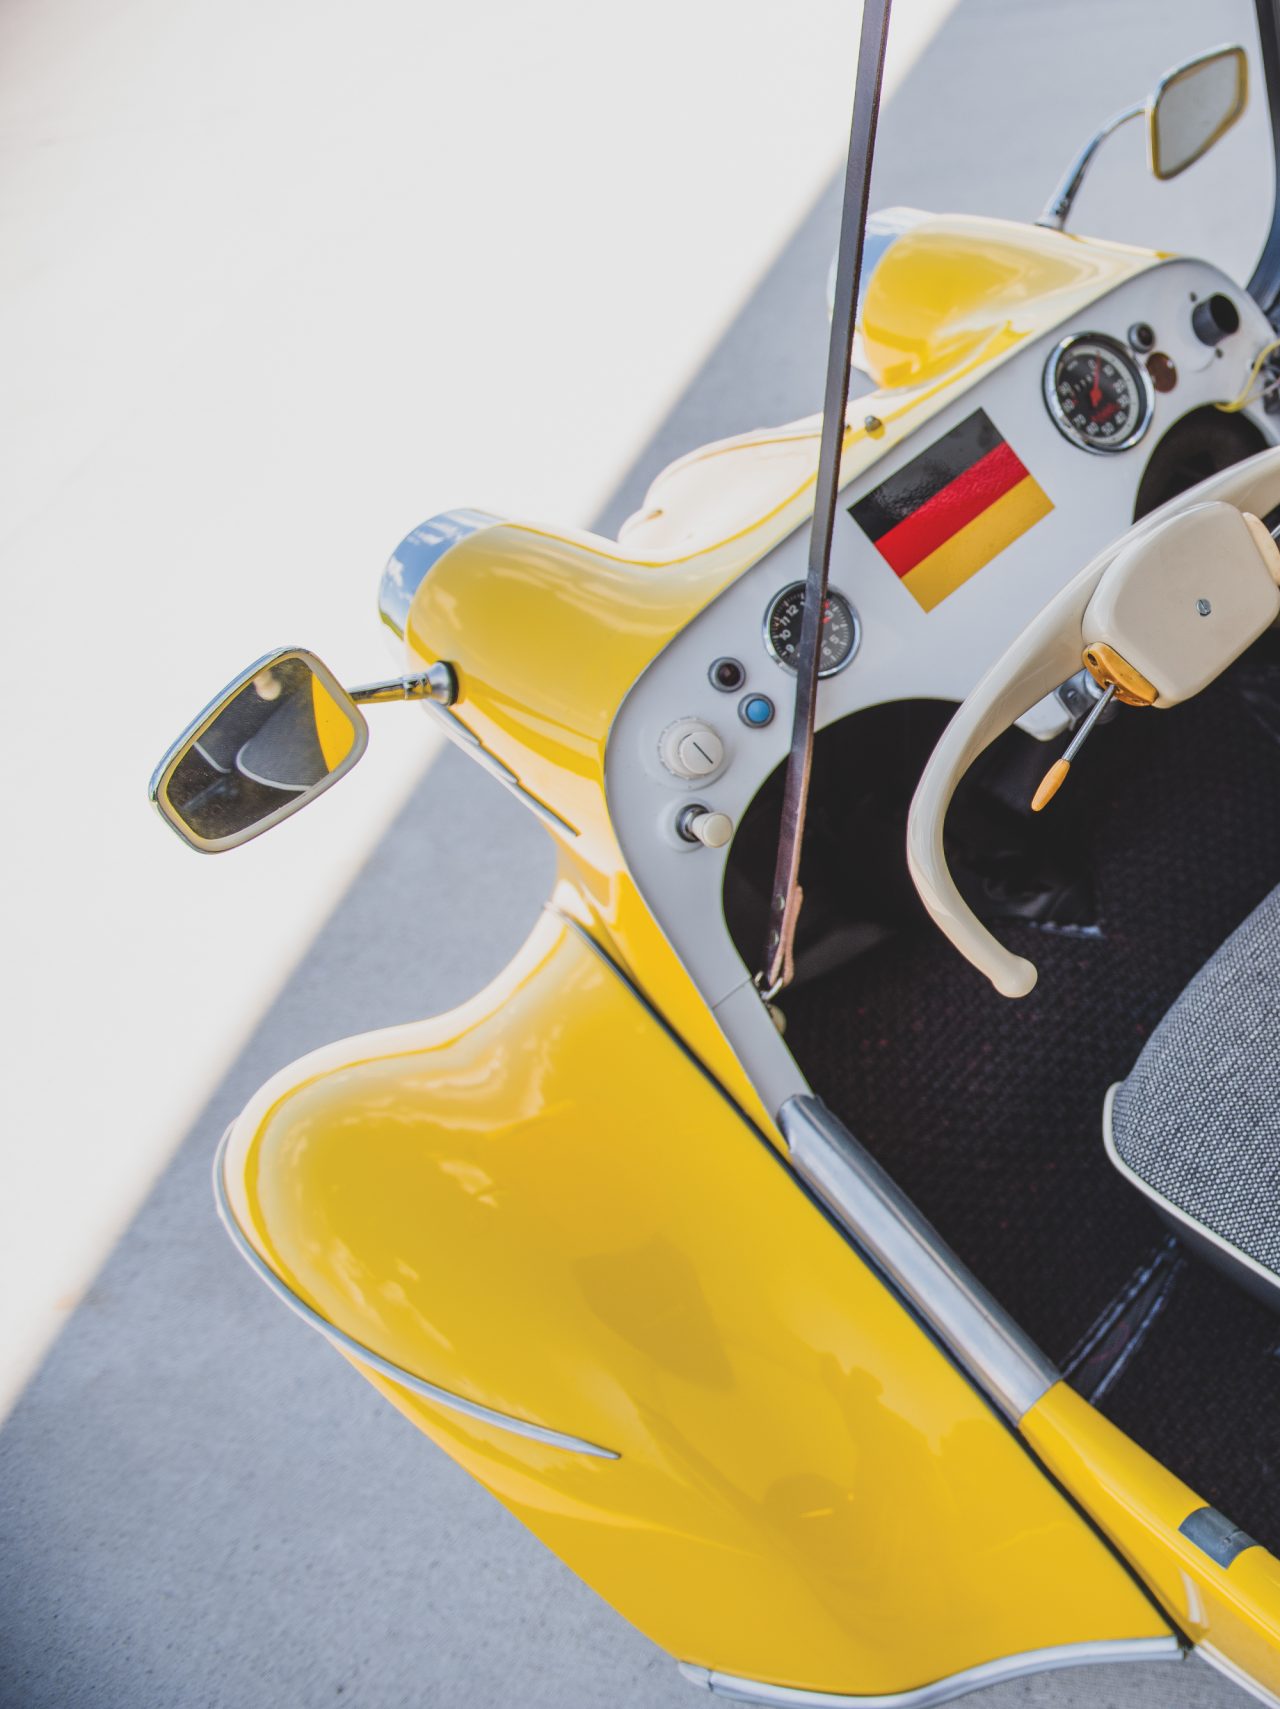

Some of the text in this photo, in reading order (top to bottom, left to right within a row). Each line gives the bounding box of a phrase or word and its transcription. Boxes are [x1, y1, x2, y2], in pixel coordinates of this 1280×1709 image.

[786, 605, 799, 616] 12
[780, 616, 791, 626] 11
[832, 623, 840, 631] 4
[780, 629, 791, 640] 10
[830, 635, 839, 644] 5
[786, 644, 794, 653] 9
[823, 648, 831, 656] 6
